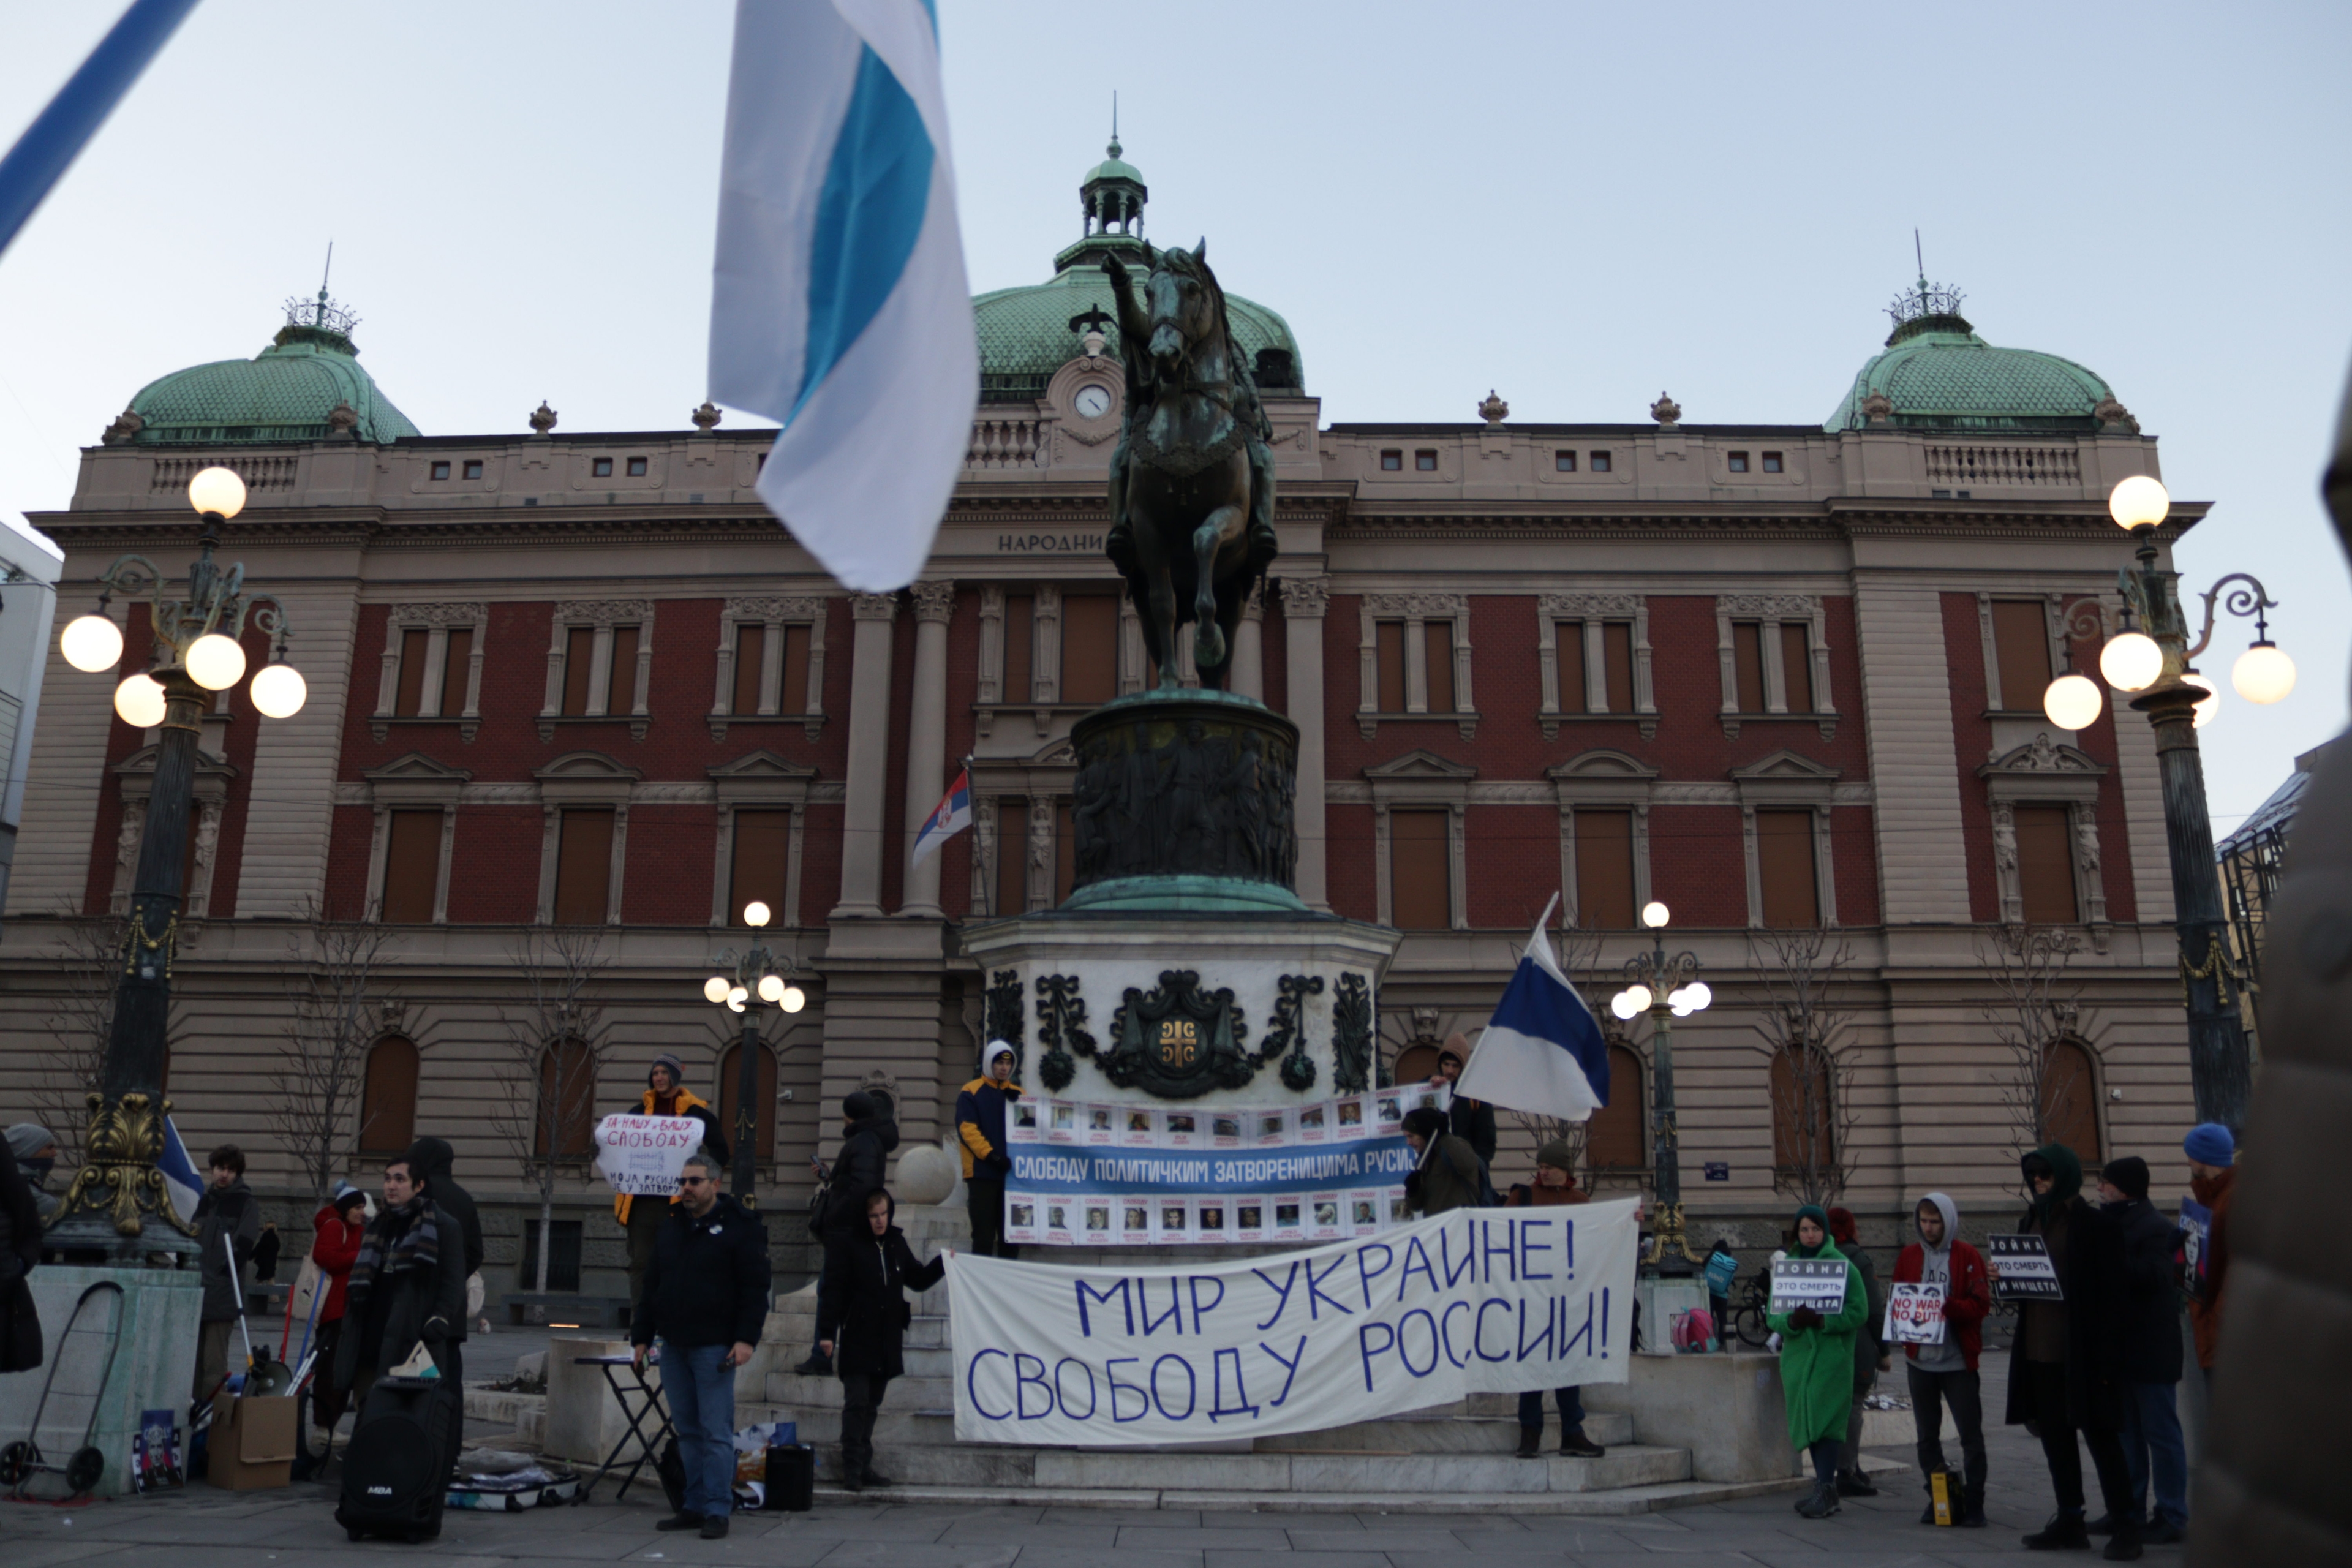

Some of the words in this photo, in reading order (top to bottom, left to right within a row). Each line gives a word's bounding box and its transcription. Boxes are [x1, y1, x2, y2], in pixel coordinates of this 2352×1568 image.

[999, 535, 1102, 551] НАРОДНИ
[606, 1117, 617, 1128] ЗА
[622, 1118, 650, 1129] НАШУ
[660, 1120, 692, 1131] ВАШУ
[608, 1131, 690, 1148] СЛОБОДУ
[1015, 1156, 1089, 1183] СЛОБОДУ
[1095, 1159, 1208, 1183] ПОЛИТИЧКИМ
[1215, 1154, 1359, 1182] ЗАТВОРЕНИЦИМА
[610, 1172, 638, 1183] МОЈА
[627, 1184, 633, 1193] У
[639, 1184, 680, 1193] ЗАТВОРУ
[1989, 1238, 2043, 1251] ВОЙНА
[1777, 1262, 1844, 1275] ВОЙНА
[2013, 1262, 2049, 1271] СМЕРТЬ
[1074, 1273, 1225, 1338] МИР
[1252, 1219, 1576, 1330] УКРАИНЕ!
[1776, 1282, 1796, 1291] ЭТО
[1800, 1282, 1841, 1291] СМЕРТЬ
[1999, 1281, 2007, 1291] И
[2011, 1281, 2058, 1292] НИЩЕТА
[1774, 1299, 1782, 1308] И
[1893, 1298, 1912, 1310] NO
[1916, 1298, 1940, 1310] WAR
[1892, 1310, 1910, 1321] NO
[967, 1335, 1308, 1424] СВОБОДУ
[1360, 1287, 1610, 1393] РОССИИ!
[367, 1485, 393, 1496] MBA
